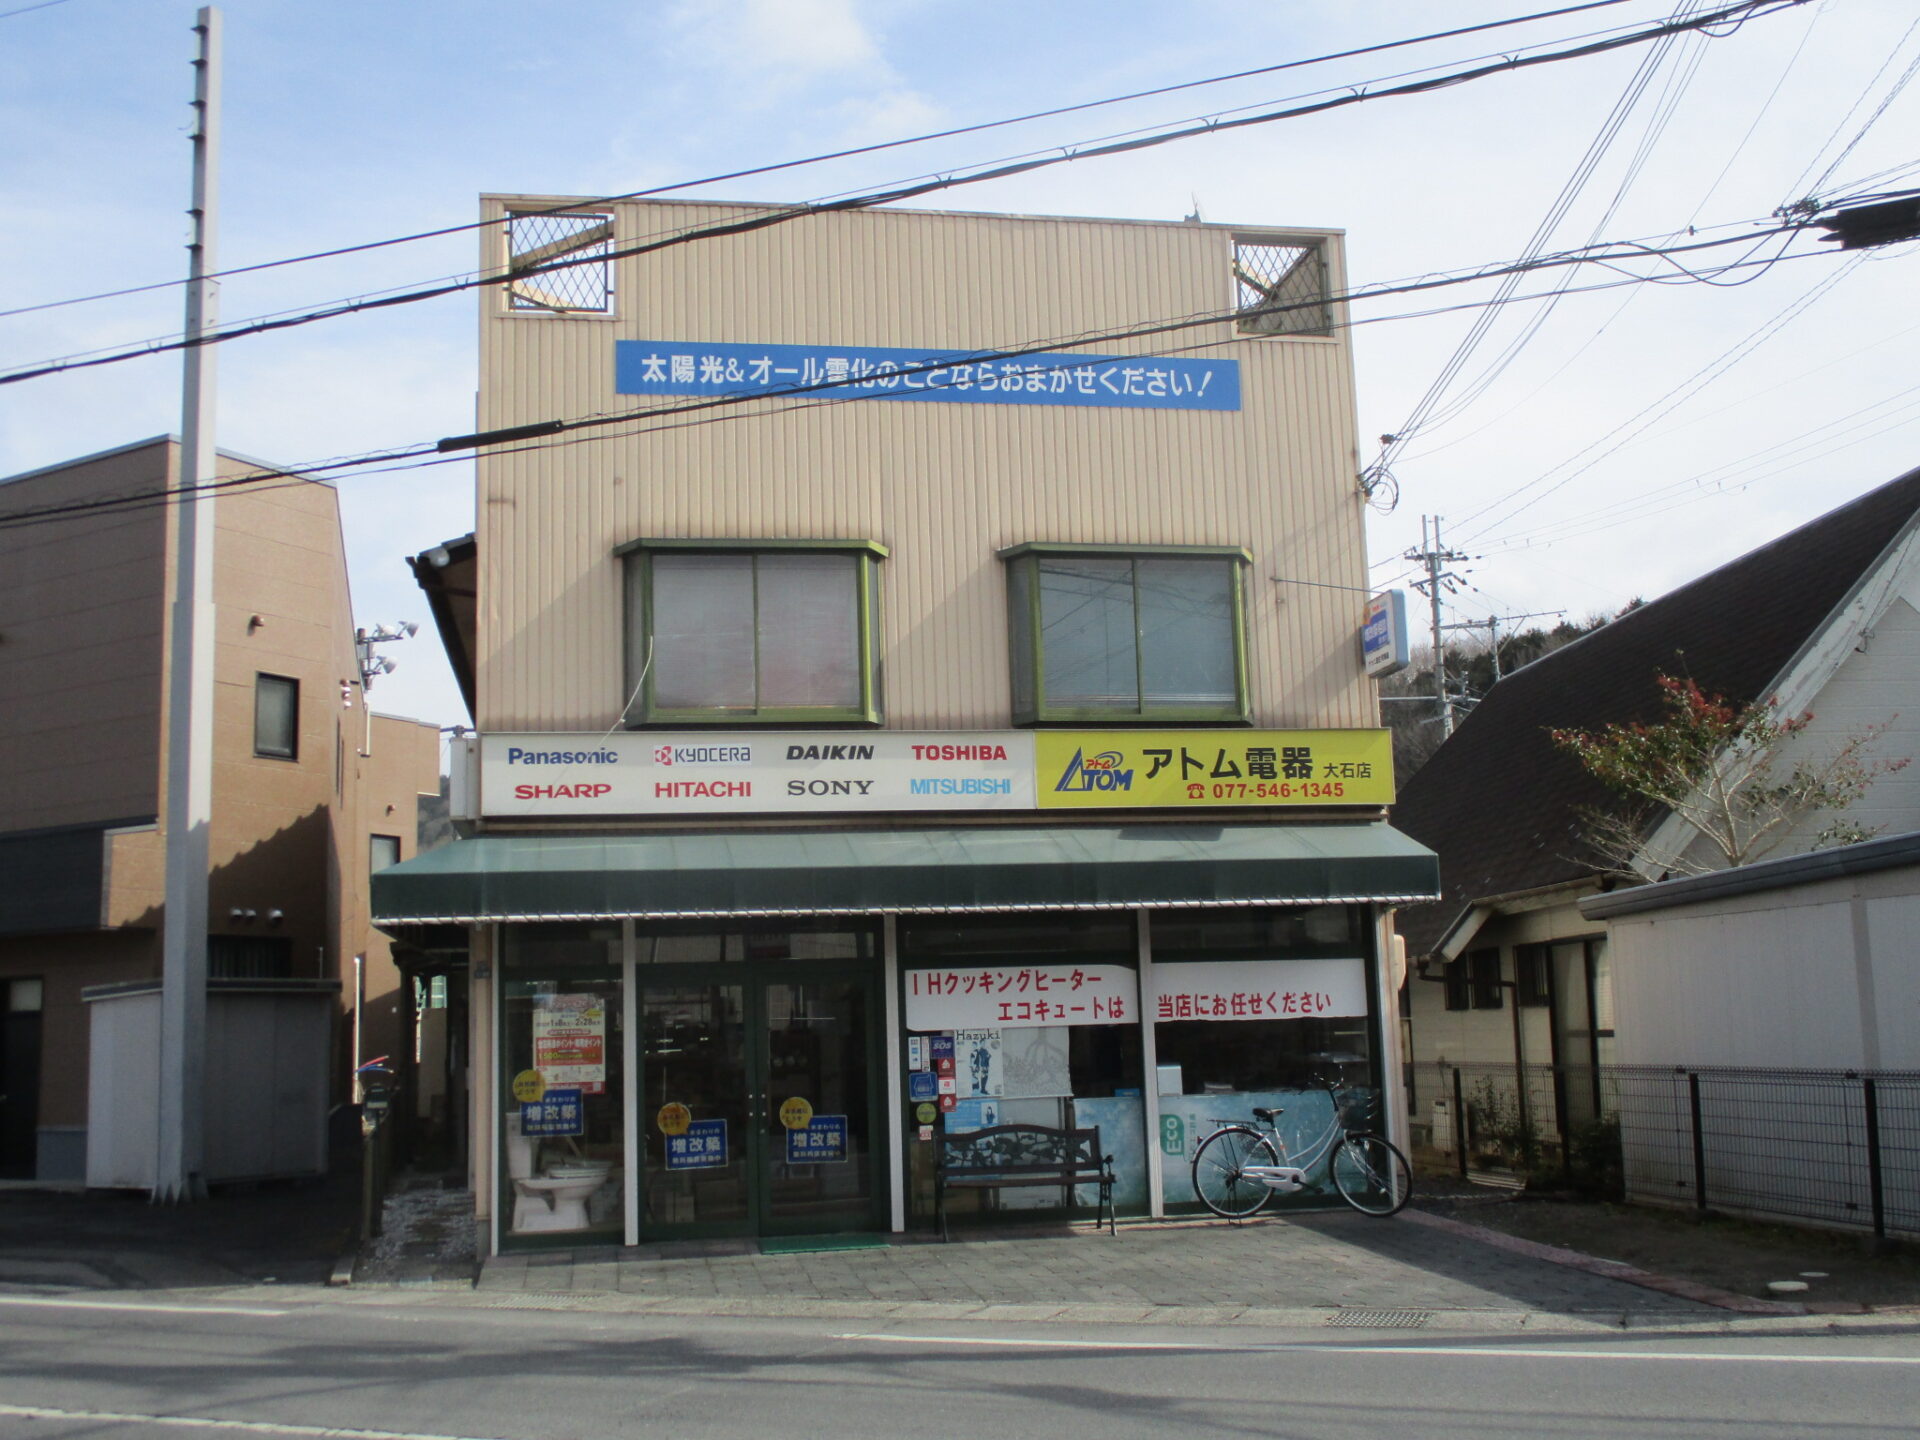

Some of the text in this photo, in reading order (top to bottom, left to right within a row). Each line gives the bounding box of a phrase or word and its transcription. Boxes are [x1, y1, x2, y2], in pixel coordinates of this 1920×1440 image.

[508, 747, 618, 765] Panasonic
[674, 746, 752, 763] KYOCERA
[786, 745, 875, 760] DAIKIN
[911, 744, 1008, 761] TOSHIBA
[1085, 758, 1112, 769] アトム
[1142, 746, 1372, 781] アトム電器 大石店
[514, 783, 612, 800] SHARP
[655, 781, 752, 798] HITACHI
[787, 780, 875, 796] SONY
[910, 778, 1012, 795] MITSUBISHI
[1212, 781, 1344, 799] 077-546-1345
[997, 995, 1125, 1022] エコキュートは
[1157, 991, 1332, 1018] 当店にお任せください
[956, 1028, 1001, 1041] Hazuki
